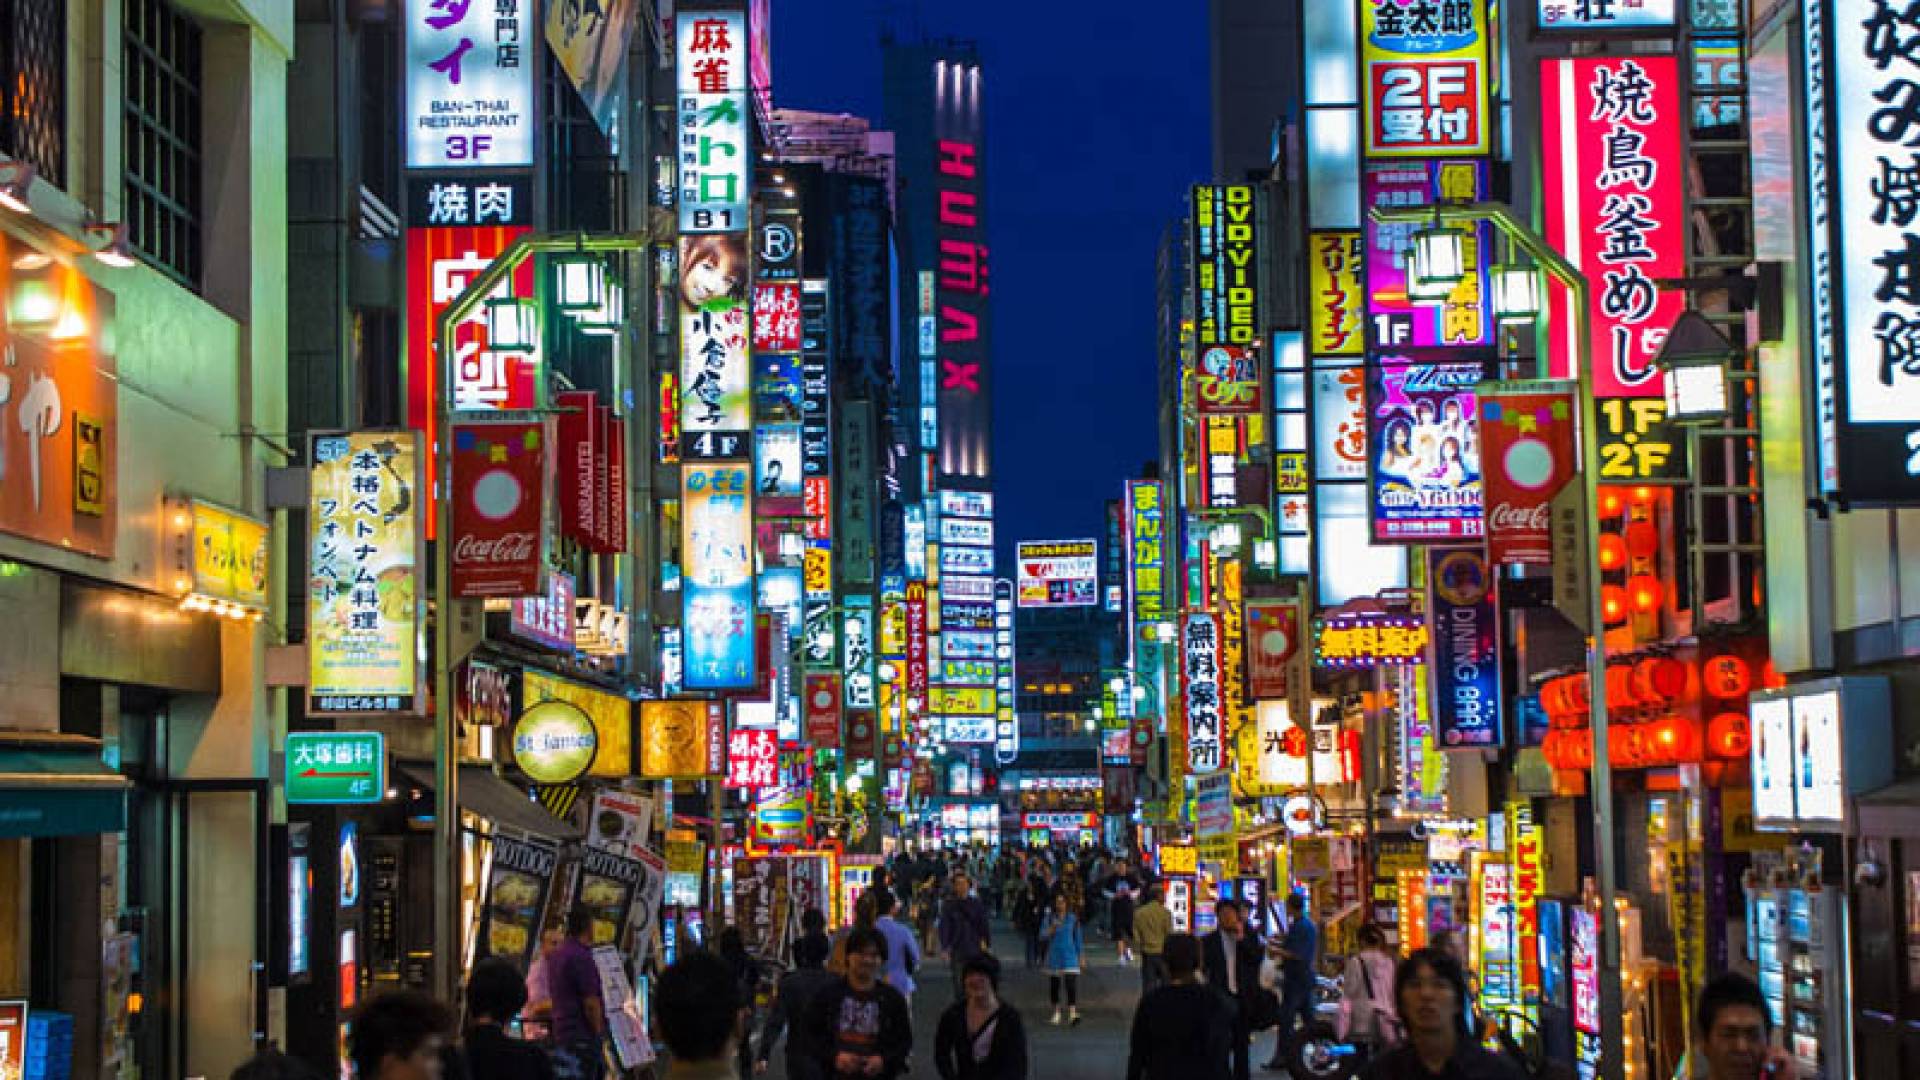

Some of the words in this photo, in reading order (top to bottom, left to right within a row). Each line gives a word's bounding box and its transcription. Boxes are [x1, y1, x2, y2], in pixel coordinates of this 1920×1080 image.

[1375, 1, 1472, 37] 金太郎
[689, 19, 732, 94] 麻雀
[1382, 67, 1467, 107] 2F
[419, 114, 519, 128] RESTAURANT
[431, 100, 510, 114] BAN-THAI
[1382, 107, 1469, 143] 受付
[446, 135, 493, 159] 3F
[428, 182, 513, 223] 焼肉
[693, 210, 732, 228] B1
[1591, 61, 1659, 384] 焼鳥釜めし
[1374, 314, 1410, 345] 1F
[1602, 400, 1667, 435] 1F
[693, 431, 738, 456] 4F
[1600, 443, 1672, 476] 2F
[352, 450, 380, 630] 本格ベトナム料理
[454, 533, 535, 564] Coca-Cola
[1451, 607, 1478, 682] DINING
[1455, 686, 1481, 728] BAR
[294, 742, 373, 765] 大塚歯科
